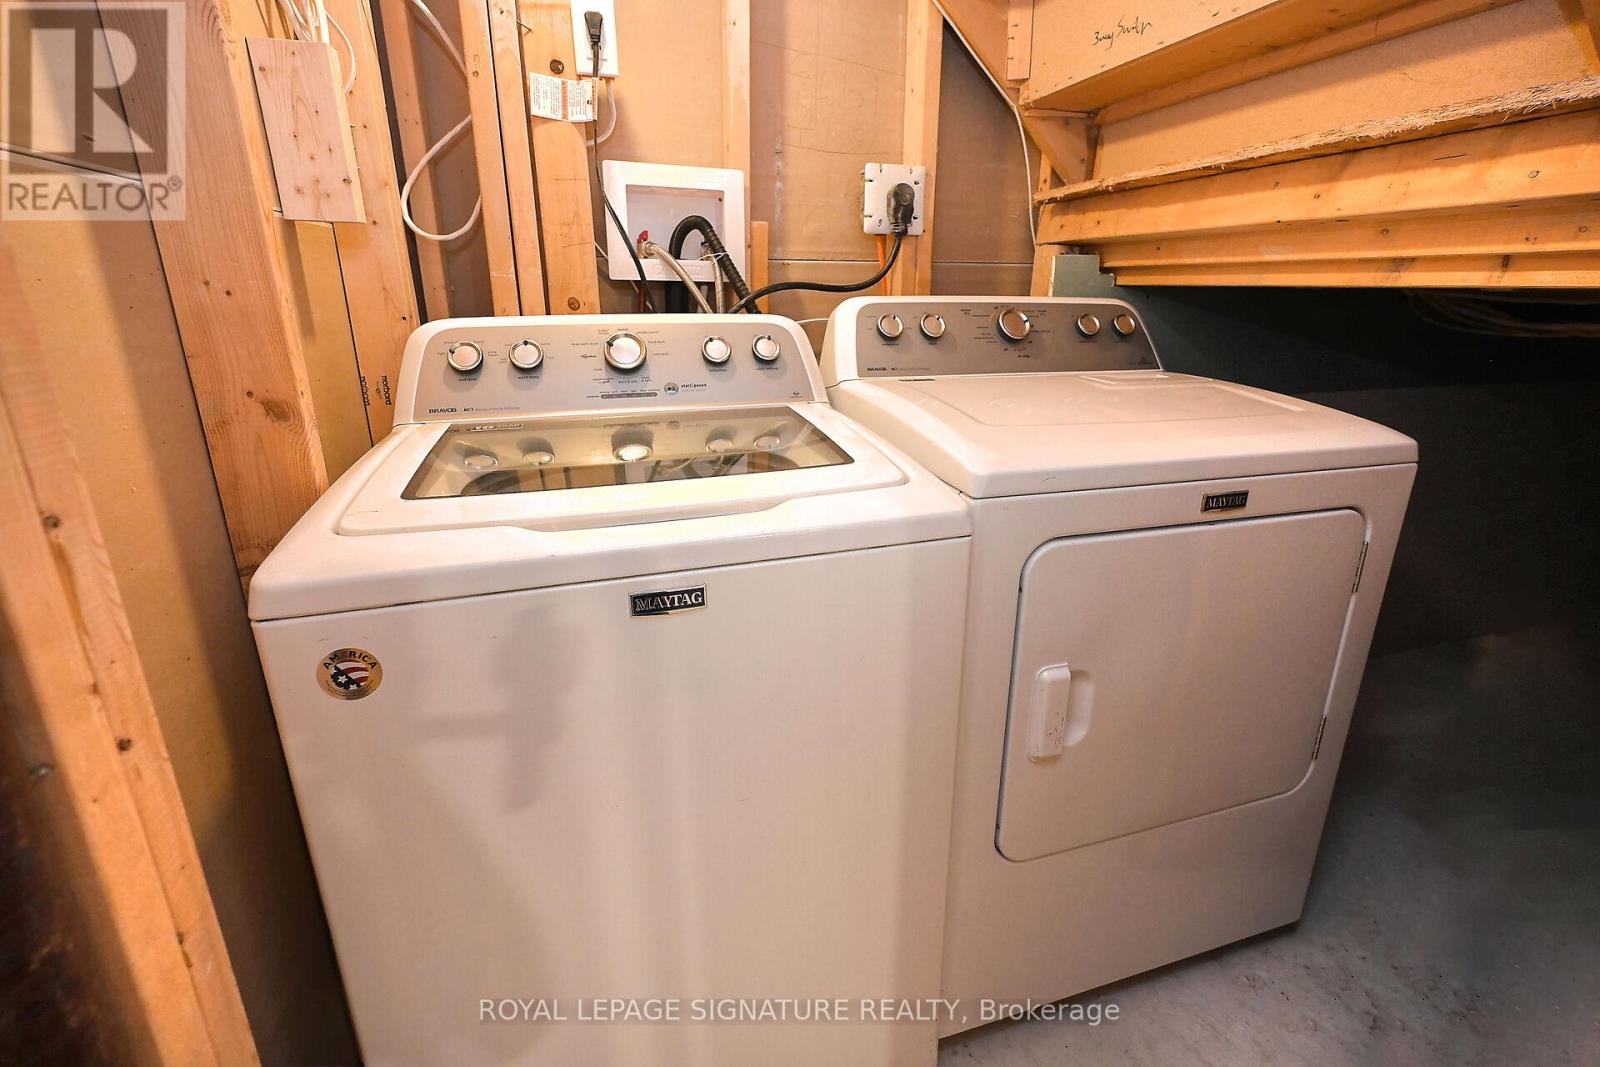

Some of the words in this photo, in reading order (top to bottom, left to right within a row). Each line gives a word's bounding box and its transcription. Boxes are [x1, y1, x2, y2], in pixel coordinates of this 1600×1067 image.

[1205, 495, 1246, 509] MAYTAG
[635, 591, 703, 612] MAYTAG
[323, 650, 377, 670] AMRICA
